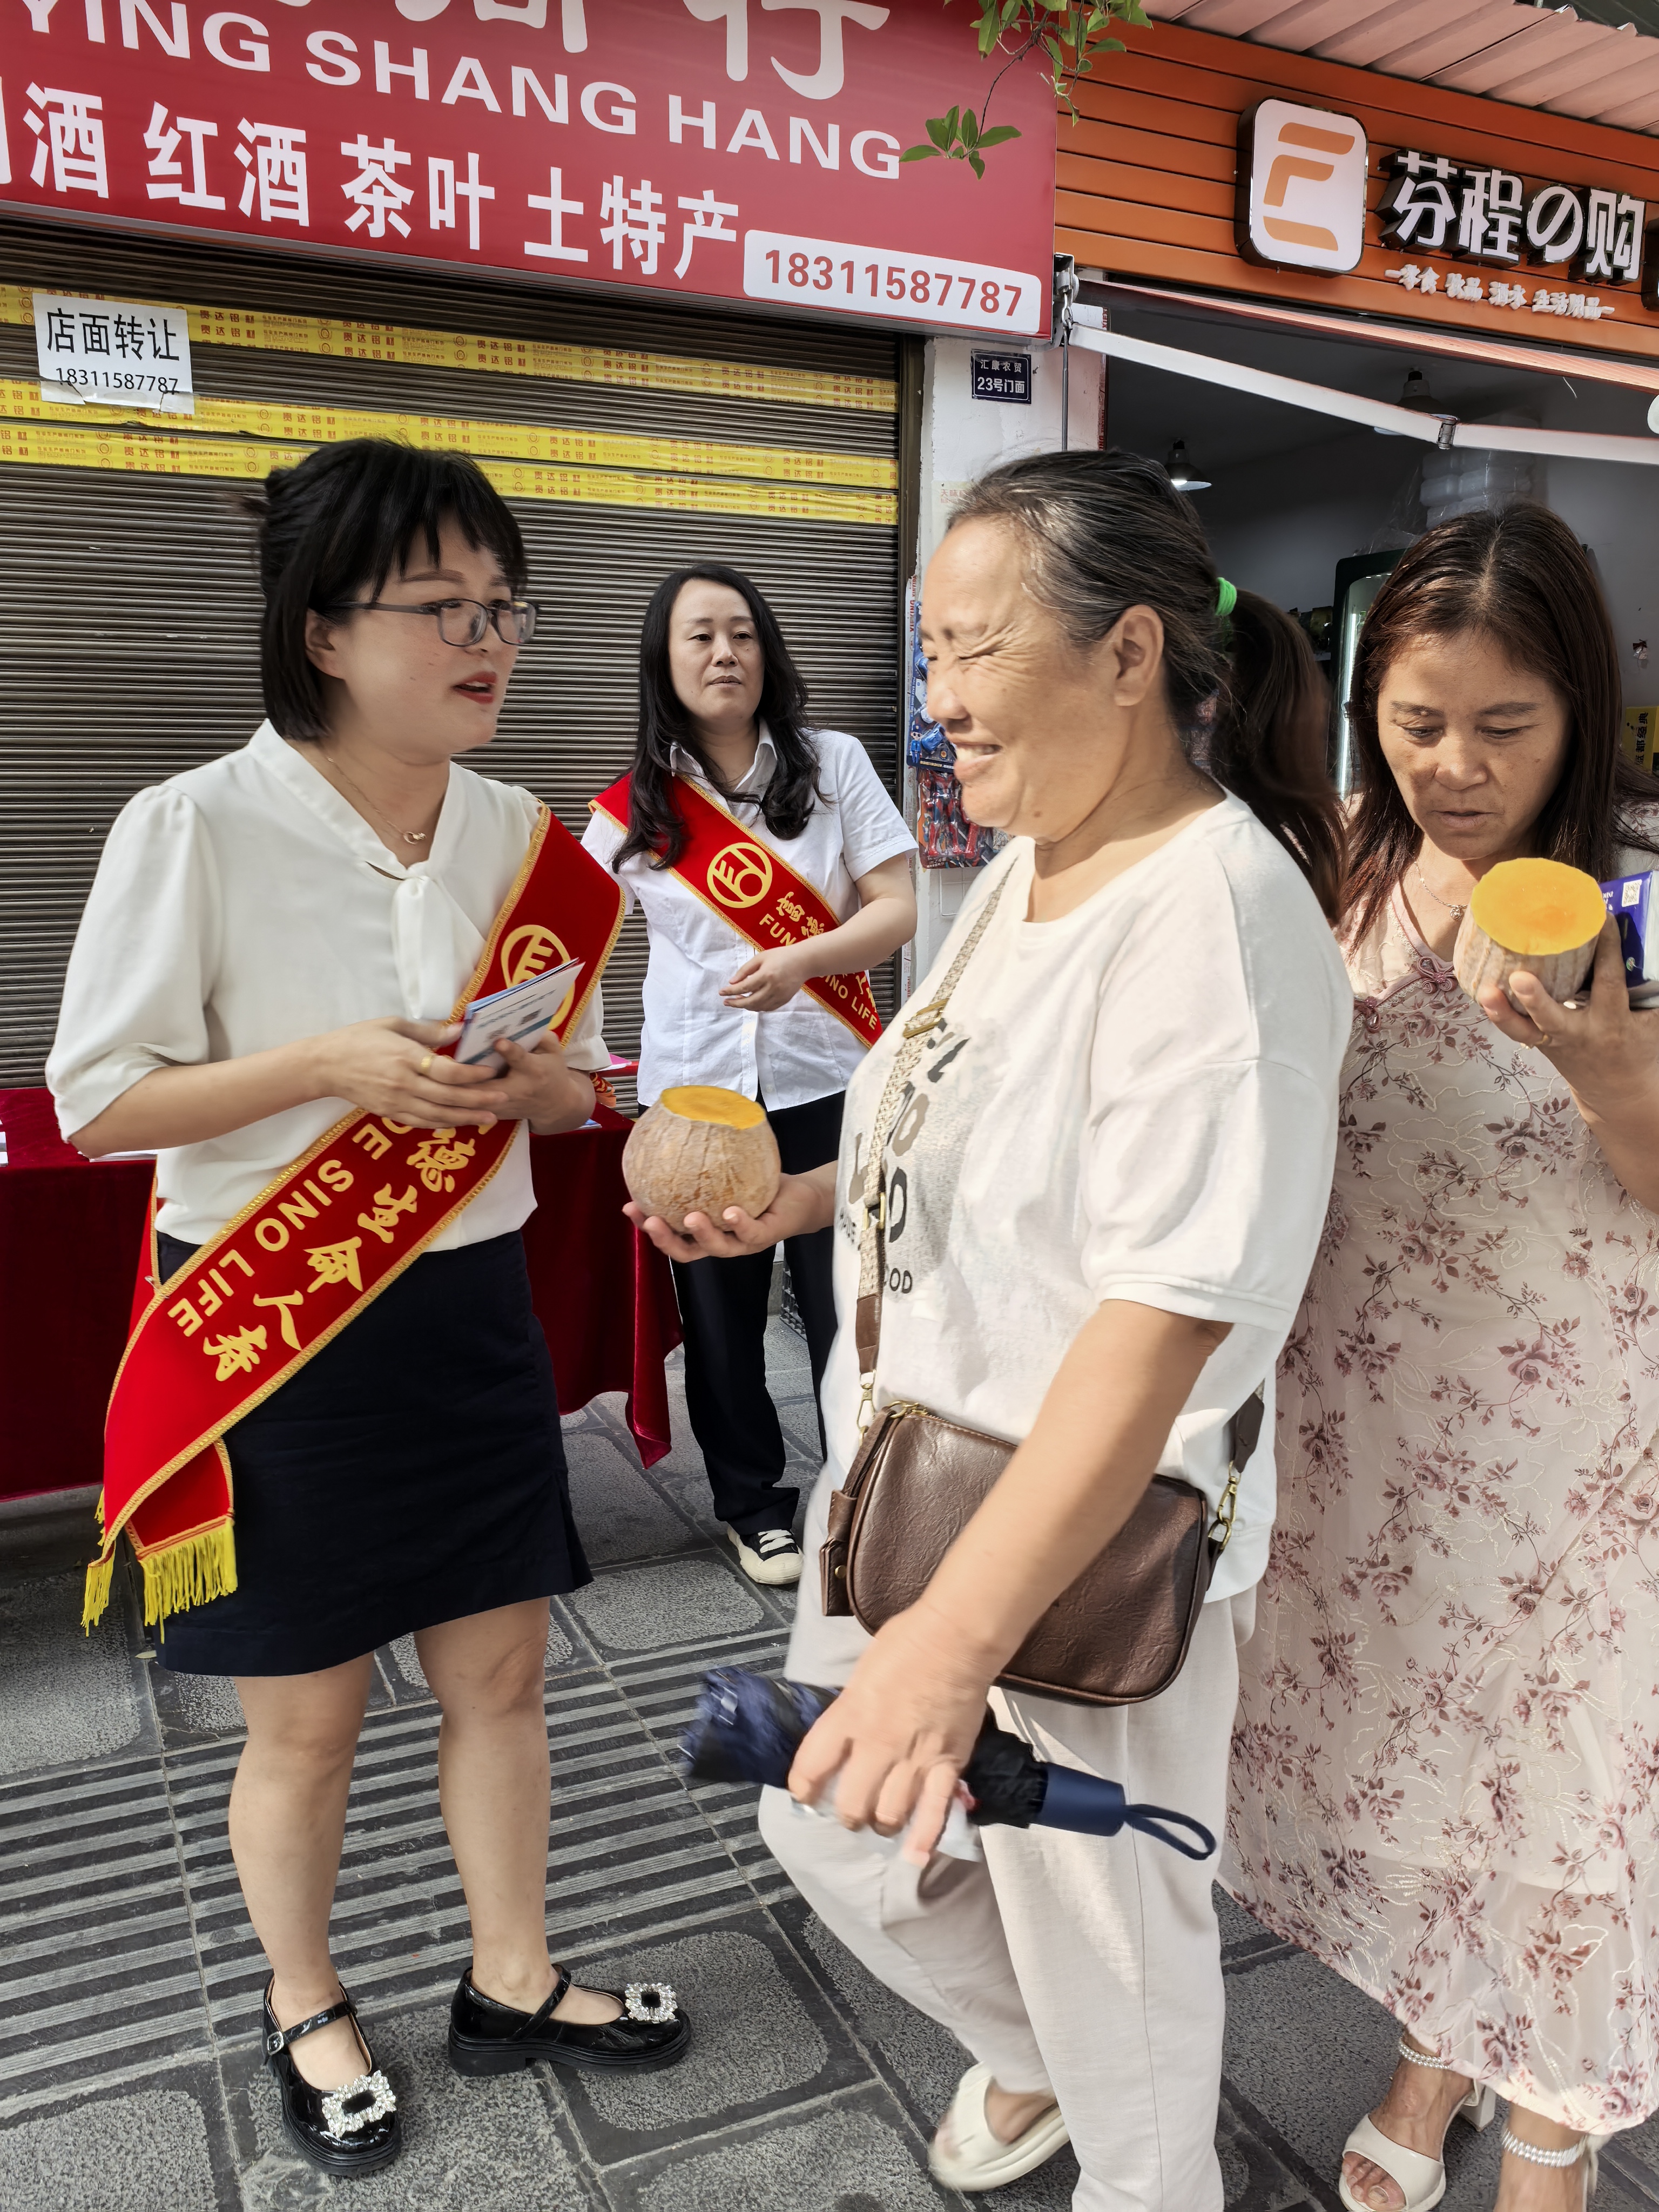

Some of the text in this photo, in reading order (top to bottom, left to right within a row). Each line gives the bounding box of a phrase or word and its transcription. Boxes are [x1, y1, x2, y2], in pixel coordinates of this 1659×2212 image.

[306, 30, 637, 134] SHANG
[669, 95, 900, 179] HANG
[0, 77, 739, 279] 酒 红酒 茶叶 土特产
[765, 248, 1022, 316] 18311587787
[47, 308, 180, 361] 店面转让
[56, 367, 180, 395] 18311587787
[977, 376, 1025, 394] 23号门面
[759, 913, 878, 1030] FUN INO LIFE
[167, 1159, 355, 1337] SINO LIFE
[203, 1123, 490, 1381] 德生命人寿
[884, 1264, 912, 1294] OD
